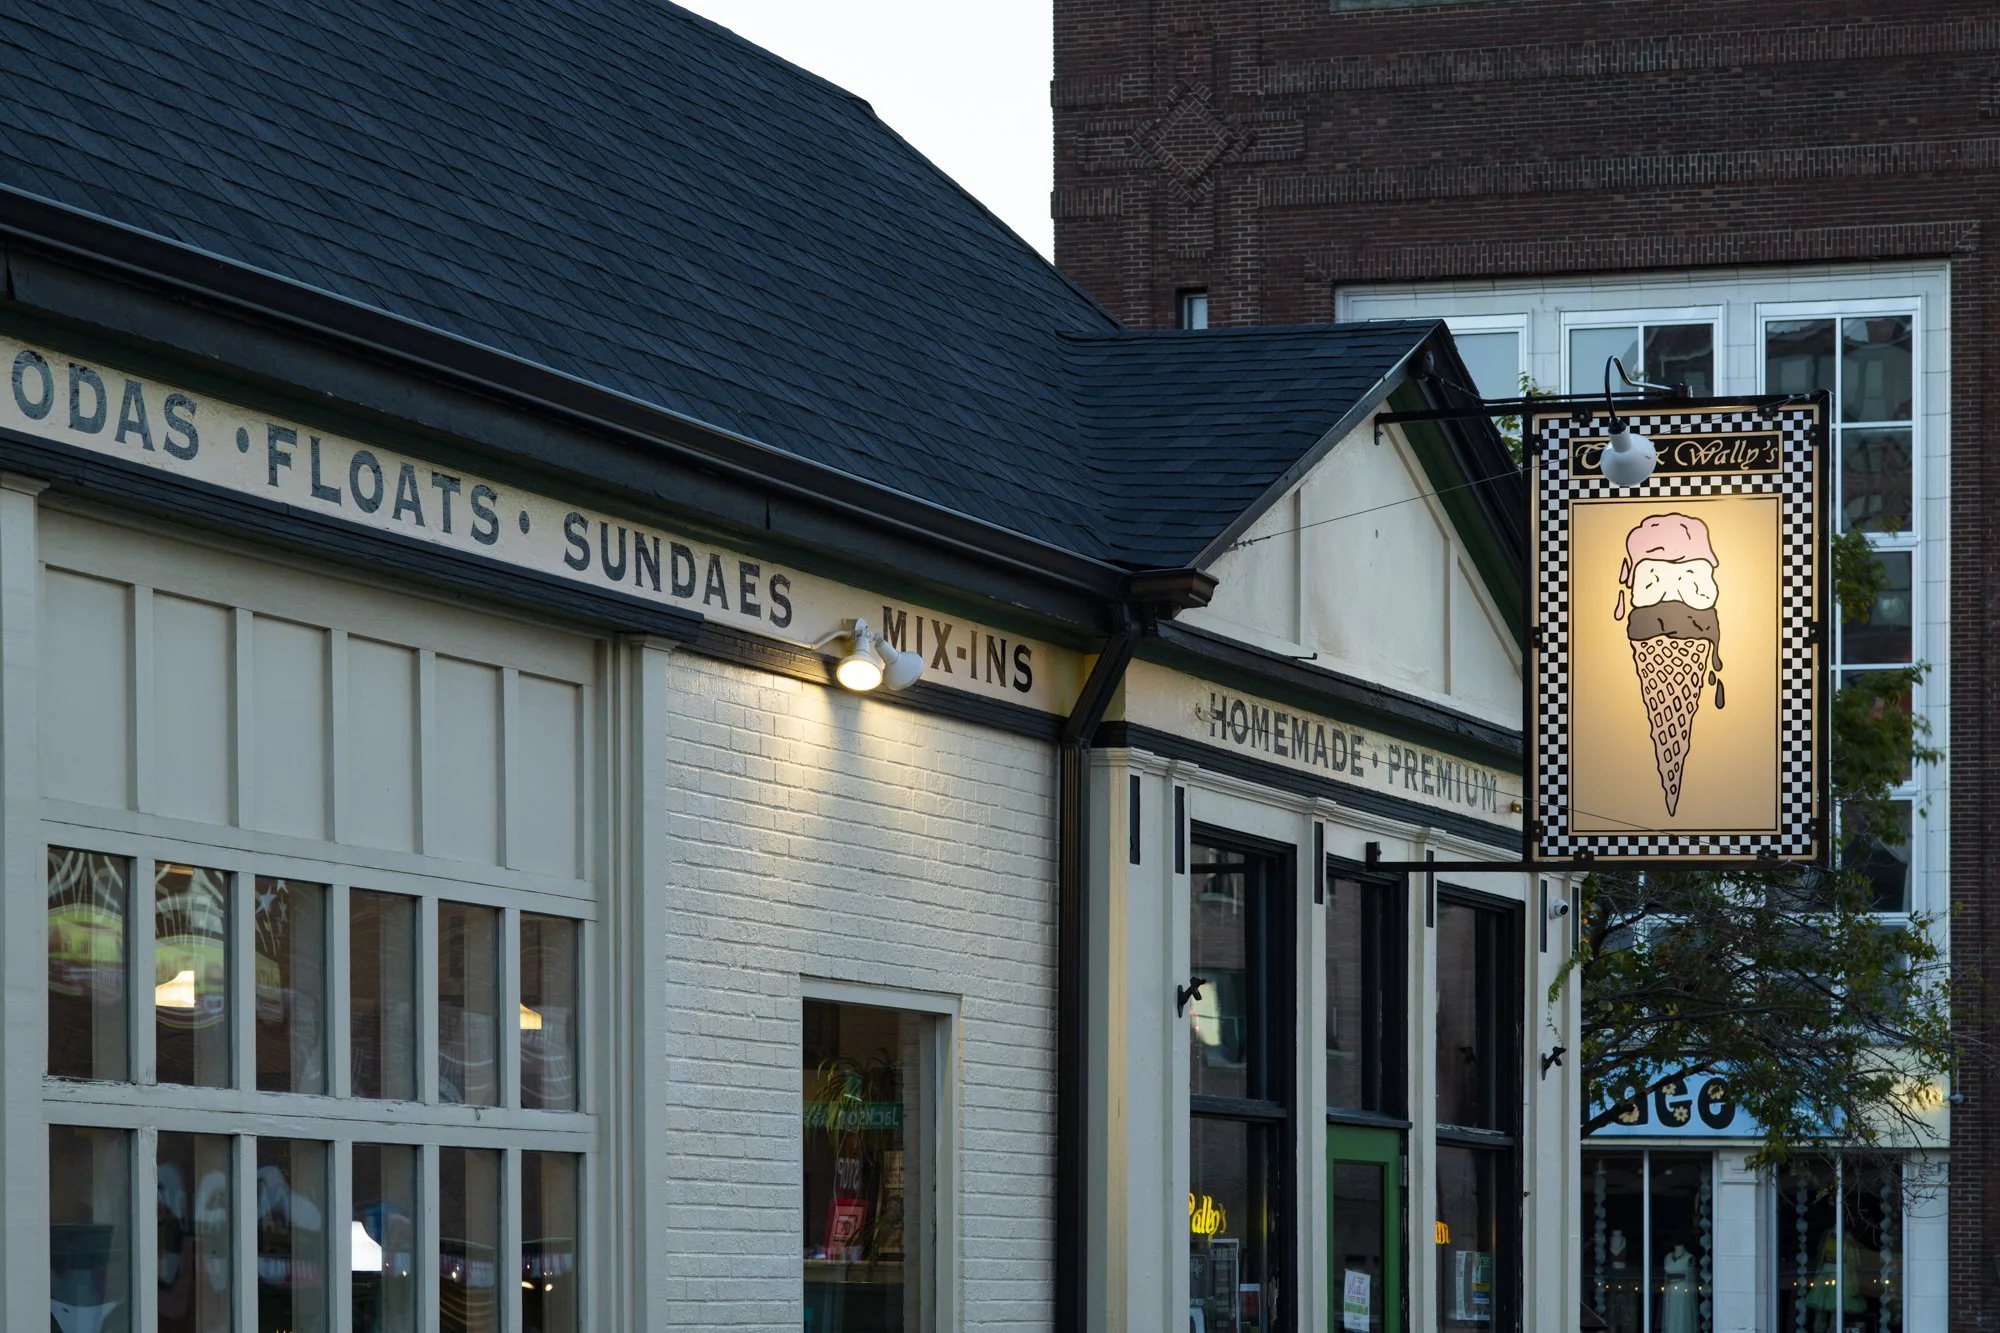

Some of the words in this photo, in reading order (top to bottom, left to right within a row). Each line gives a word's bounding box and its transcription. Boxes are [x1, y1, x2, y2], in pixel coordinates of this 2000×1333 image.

[1674, 439, 1778, 470] Wally's
[266, 422, 500, 546] FLOATS
[563, 511, 793, 628] SUNDAES
[882, 605, 1033, 693] MIX-INS
[1209, 692, 1365, 778] HOMEMADE
[1388, 743, 1498, 814] PREMIUM
